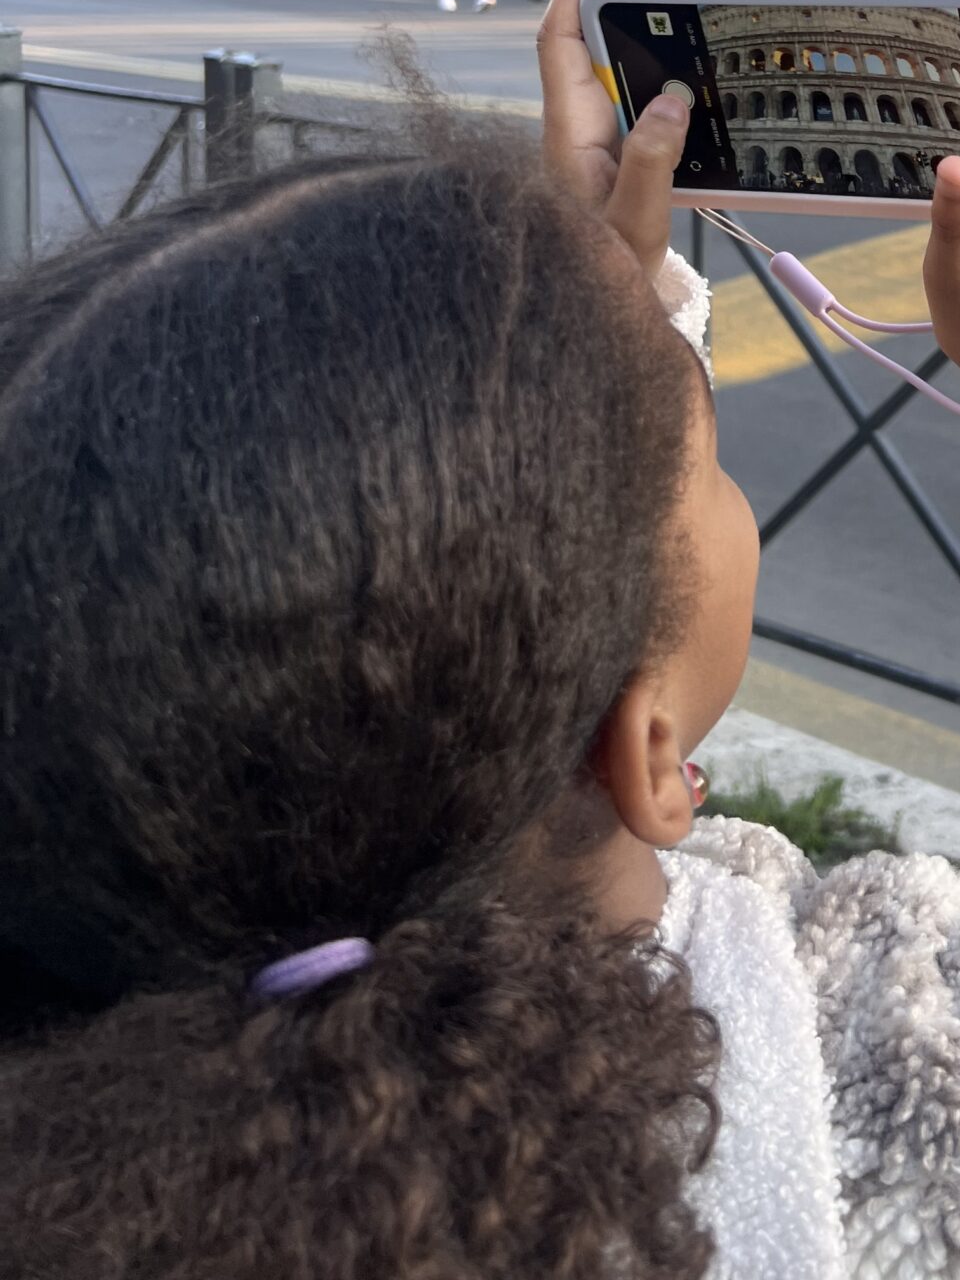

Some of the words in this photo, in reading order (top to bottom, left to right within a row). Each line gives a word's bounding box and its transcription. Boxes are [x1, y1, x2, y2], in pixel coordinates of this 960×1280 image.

[694, 56, 704, 76] VIDEO
[702, 86, 712, 108] PHOTO
[710, 118, 722, 147] PORTRAIT
